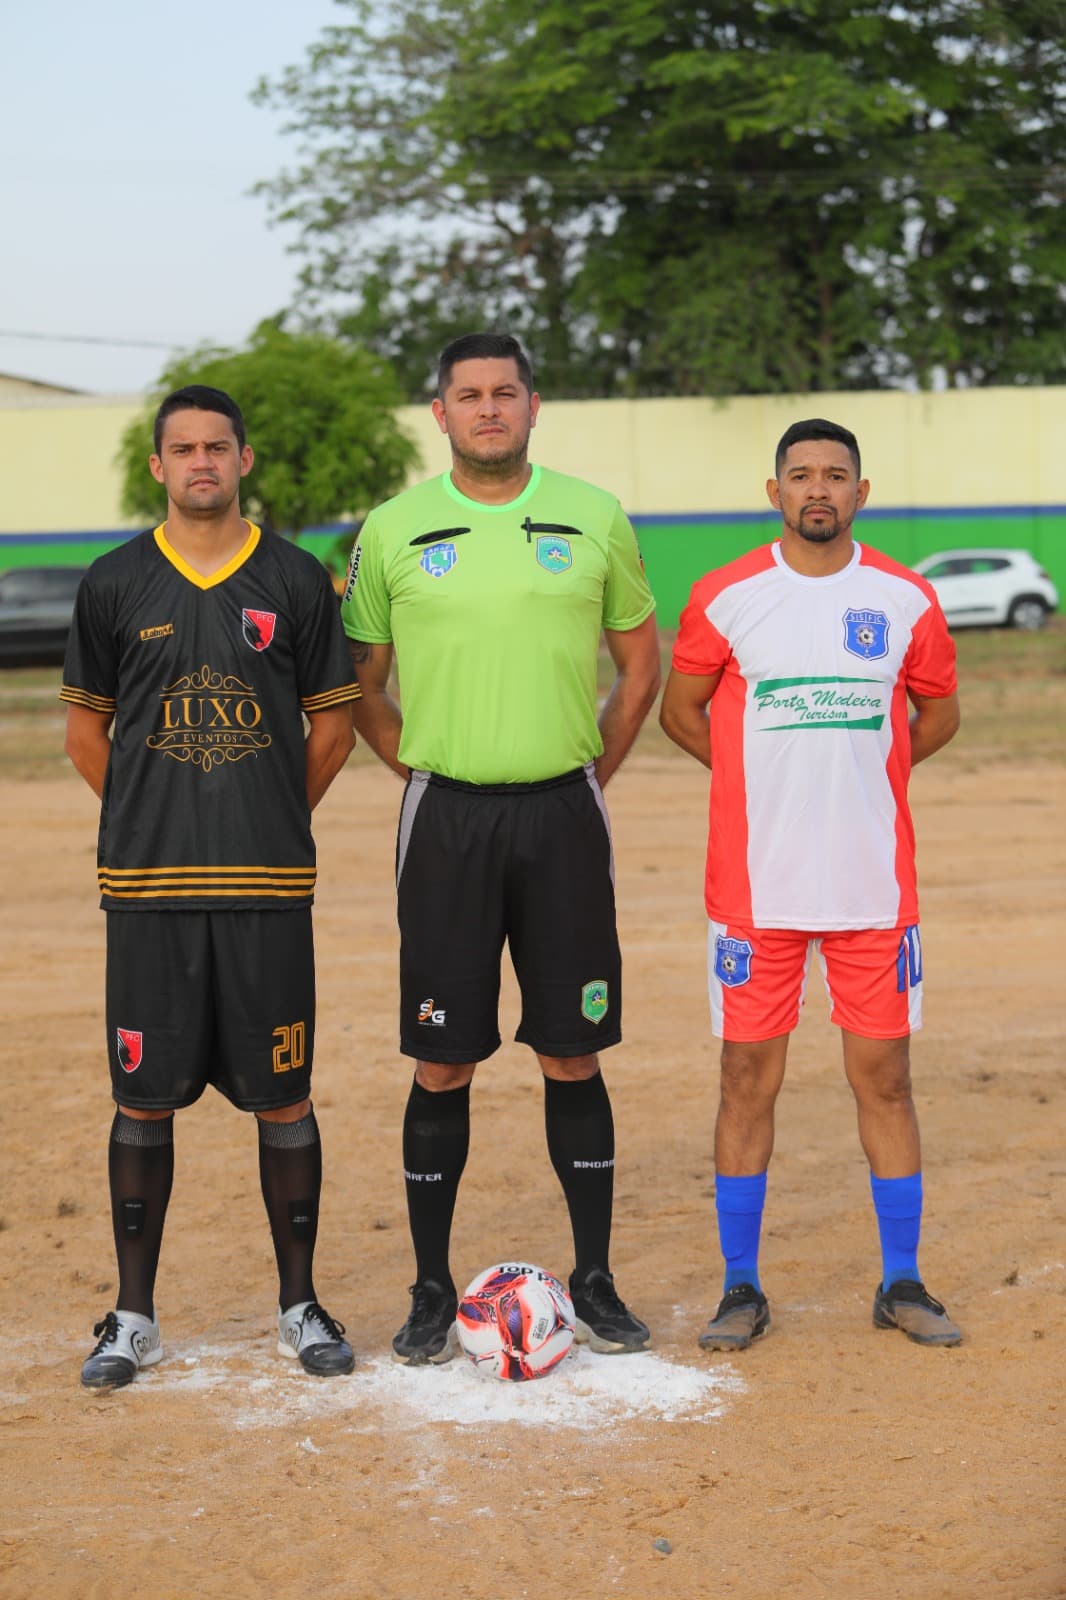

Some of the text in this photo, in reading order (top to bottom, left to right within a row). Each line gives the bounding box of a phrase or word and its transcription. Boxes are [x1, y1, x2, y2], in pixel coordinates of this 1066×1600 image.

[256, 613, 273, 623] PFC
[757, 690, 881, 712] Porto Madeira
[162, 697, 262, 729] LUXO
[794, 706, 848, 721] Turismo
[183, 733, 238, 743] EVENTOS
[272, 1021, 305, 1073] 20
